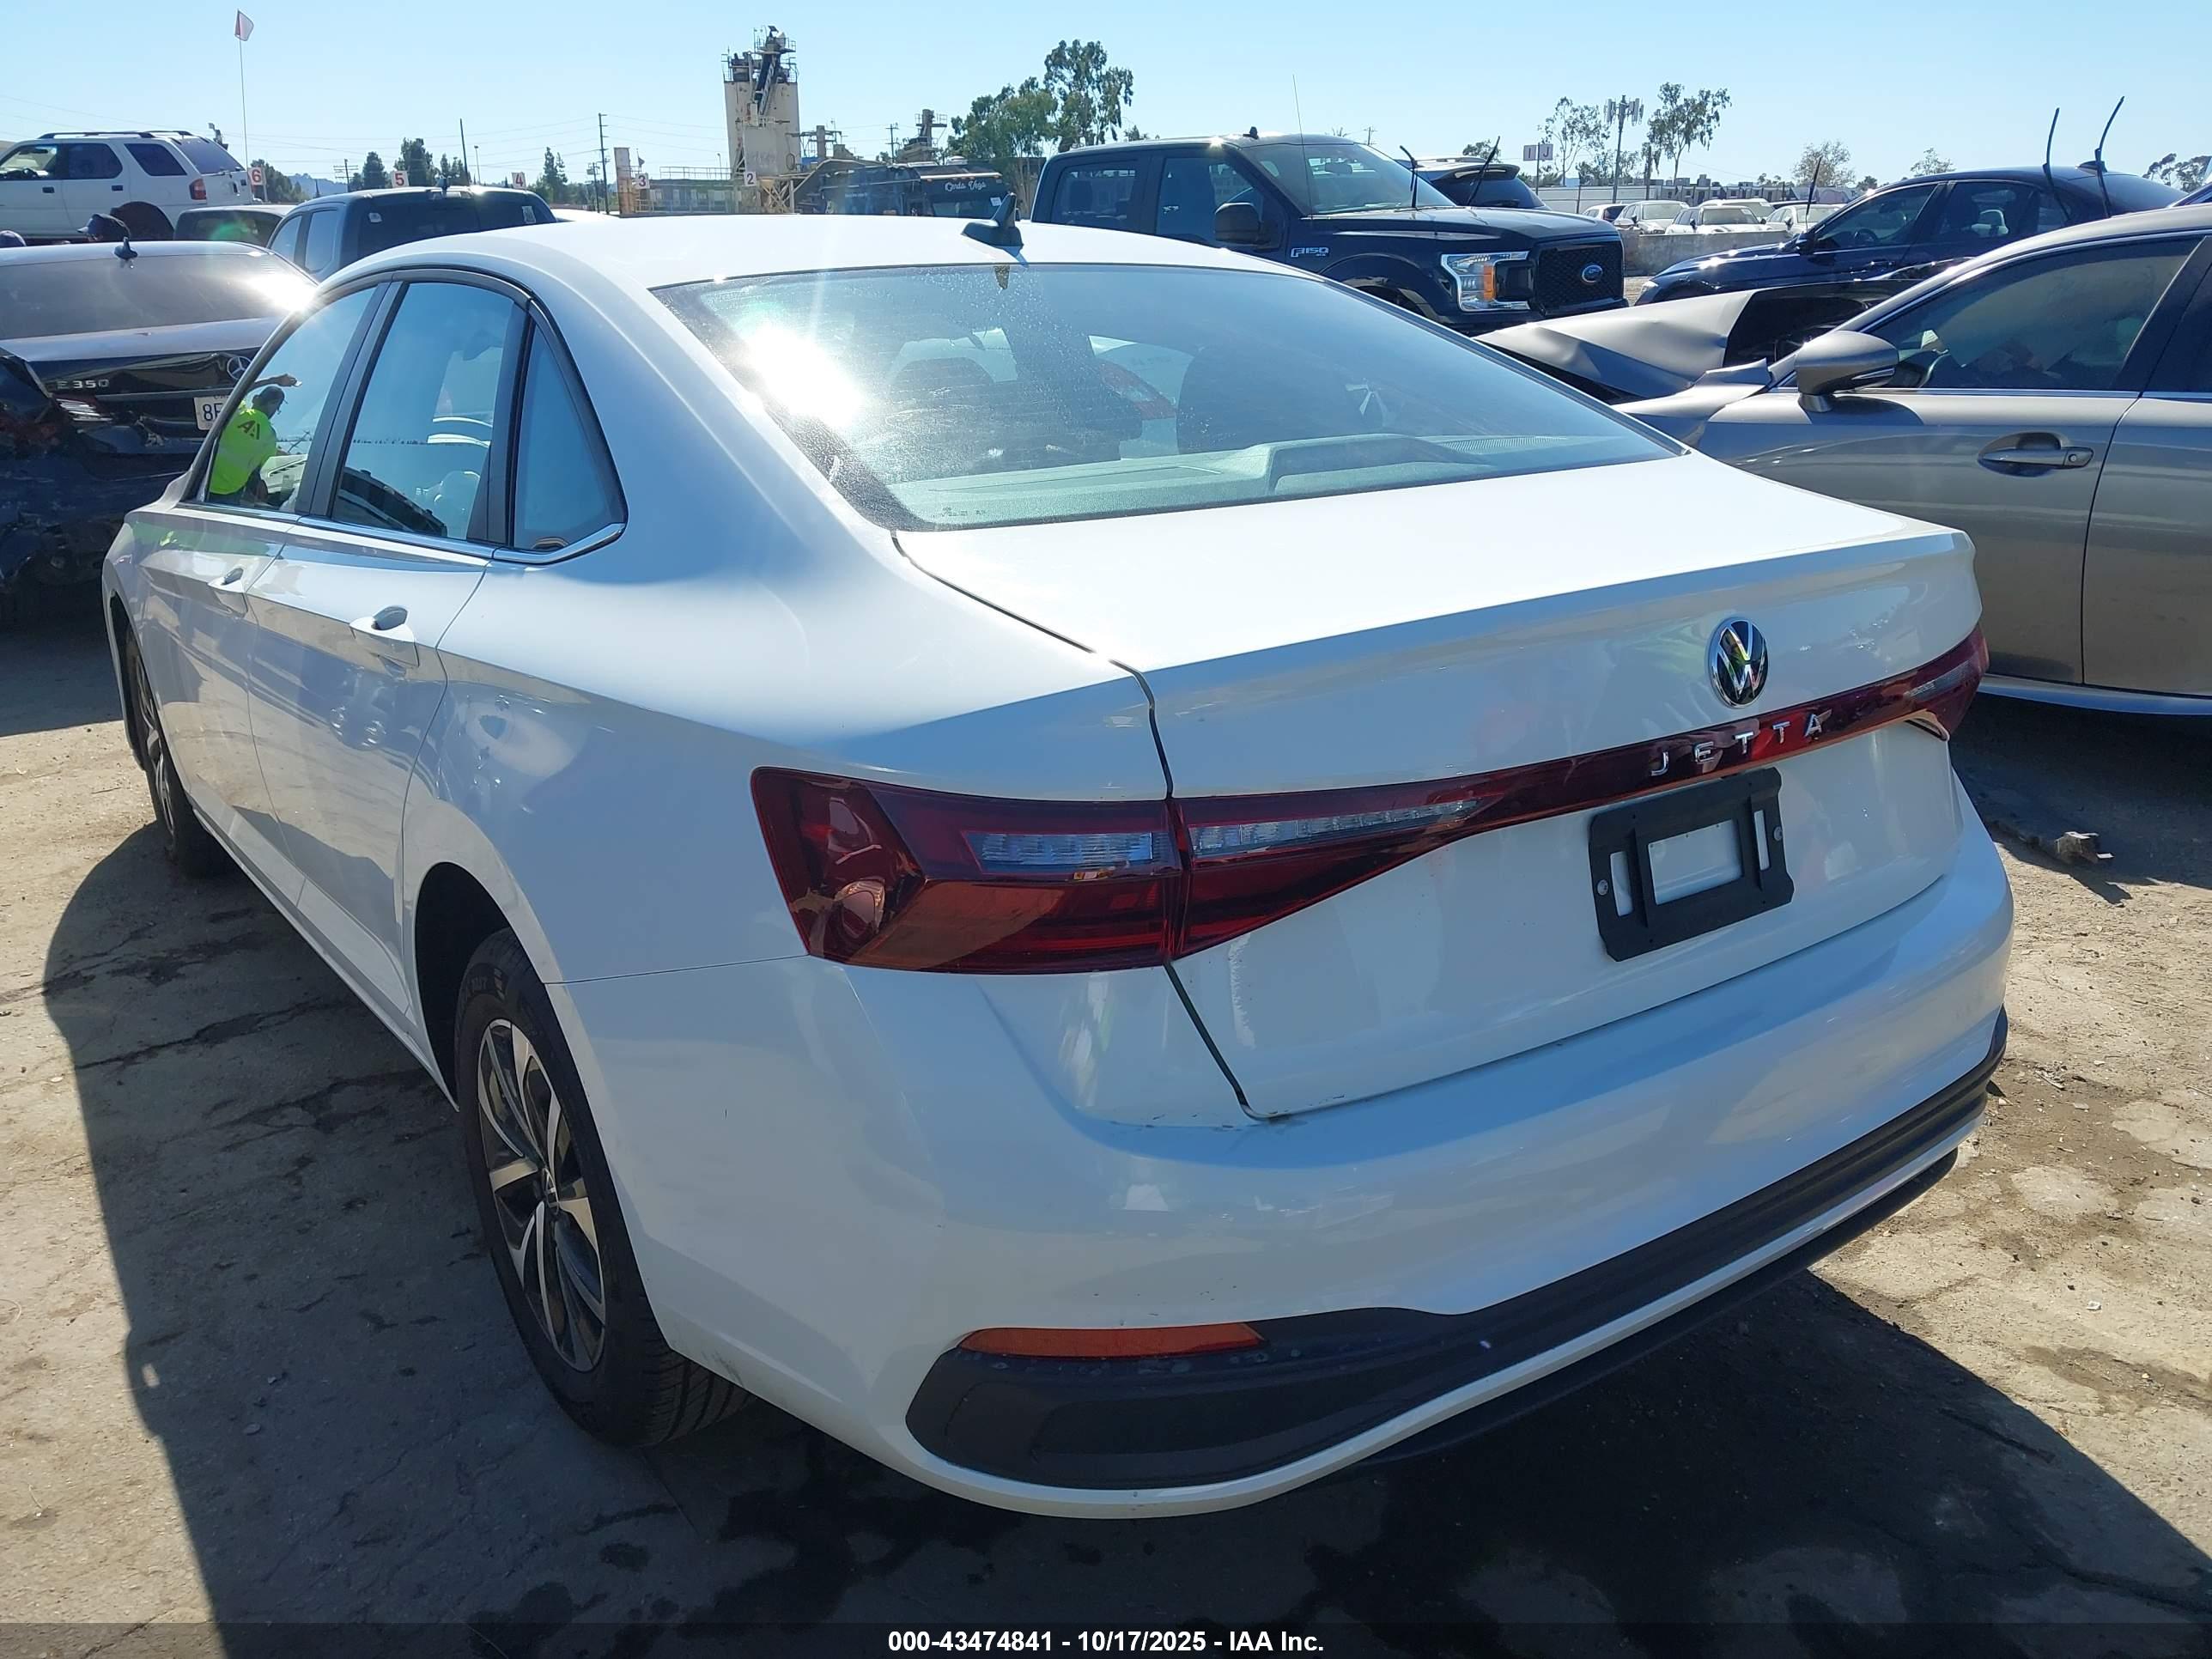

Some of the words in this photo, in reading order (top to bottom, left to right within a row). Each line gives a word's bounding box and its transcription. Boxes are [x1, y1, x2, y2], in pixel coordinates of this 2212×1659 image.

[1542, 146, 1550, 158] J
[252, 168, 262, 183] 6
[395, 173, 404, 186] 5
[515, 173, 524, 187] 4
[638, 174, 647, 187] 3
[746, 173, 754, 185] 2
[72, 379, 110, 389] 350
[1650, 714, 1823, 776] JETTA
